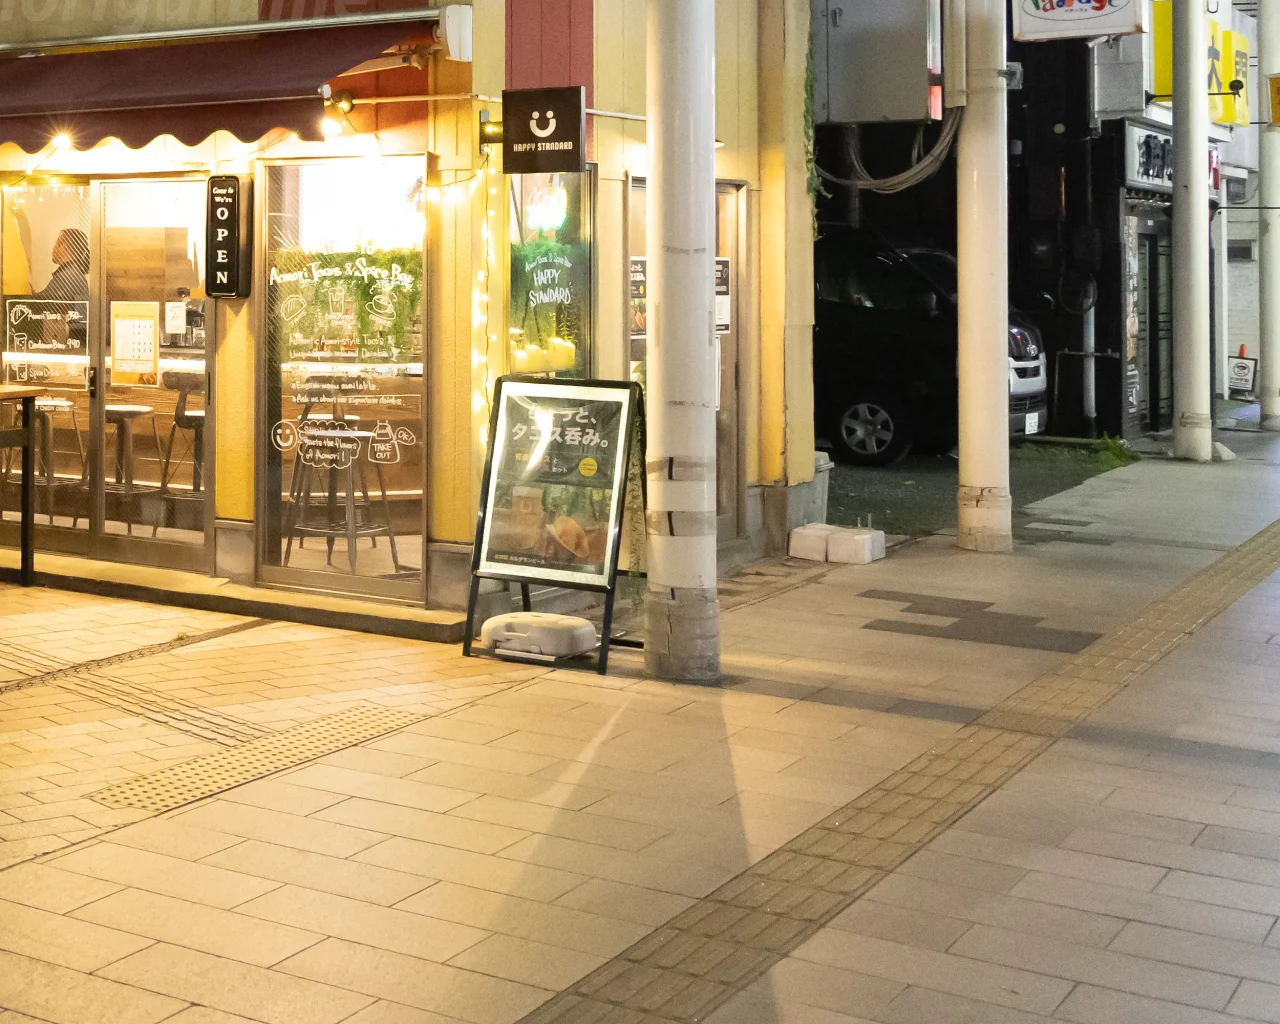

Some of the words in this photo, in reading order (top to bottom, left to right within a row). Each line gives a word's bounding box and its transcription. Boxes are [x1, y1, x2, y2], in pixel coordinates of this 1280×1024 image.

[514, 143, 536, 152] HAPPY
[537, 141, 573, 151] STANDARD
[216, 207, 229, 284] OPEN
[533, 269, 561, 286] HAPPY
[529, 287, 571, 307] STANDARD
[372, 443, 392, 451] TAKE
[376, 452, 391, 460] OUT
